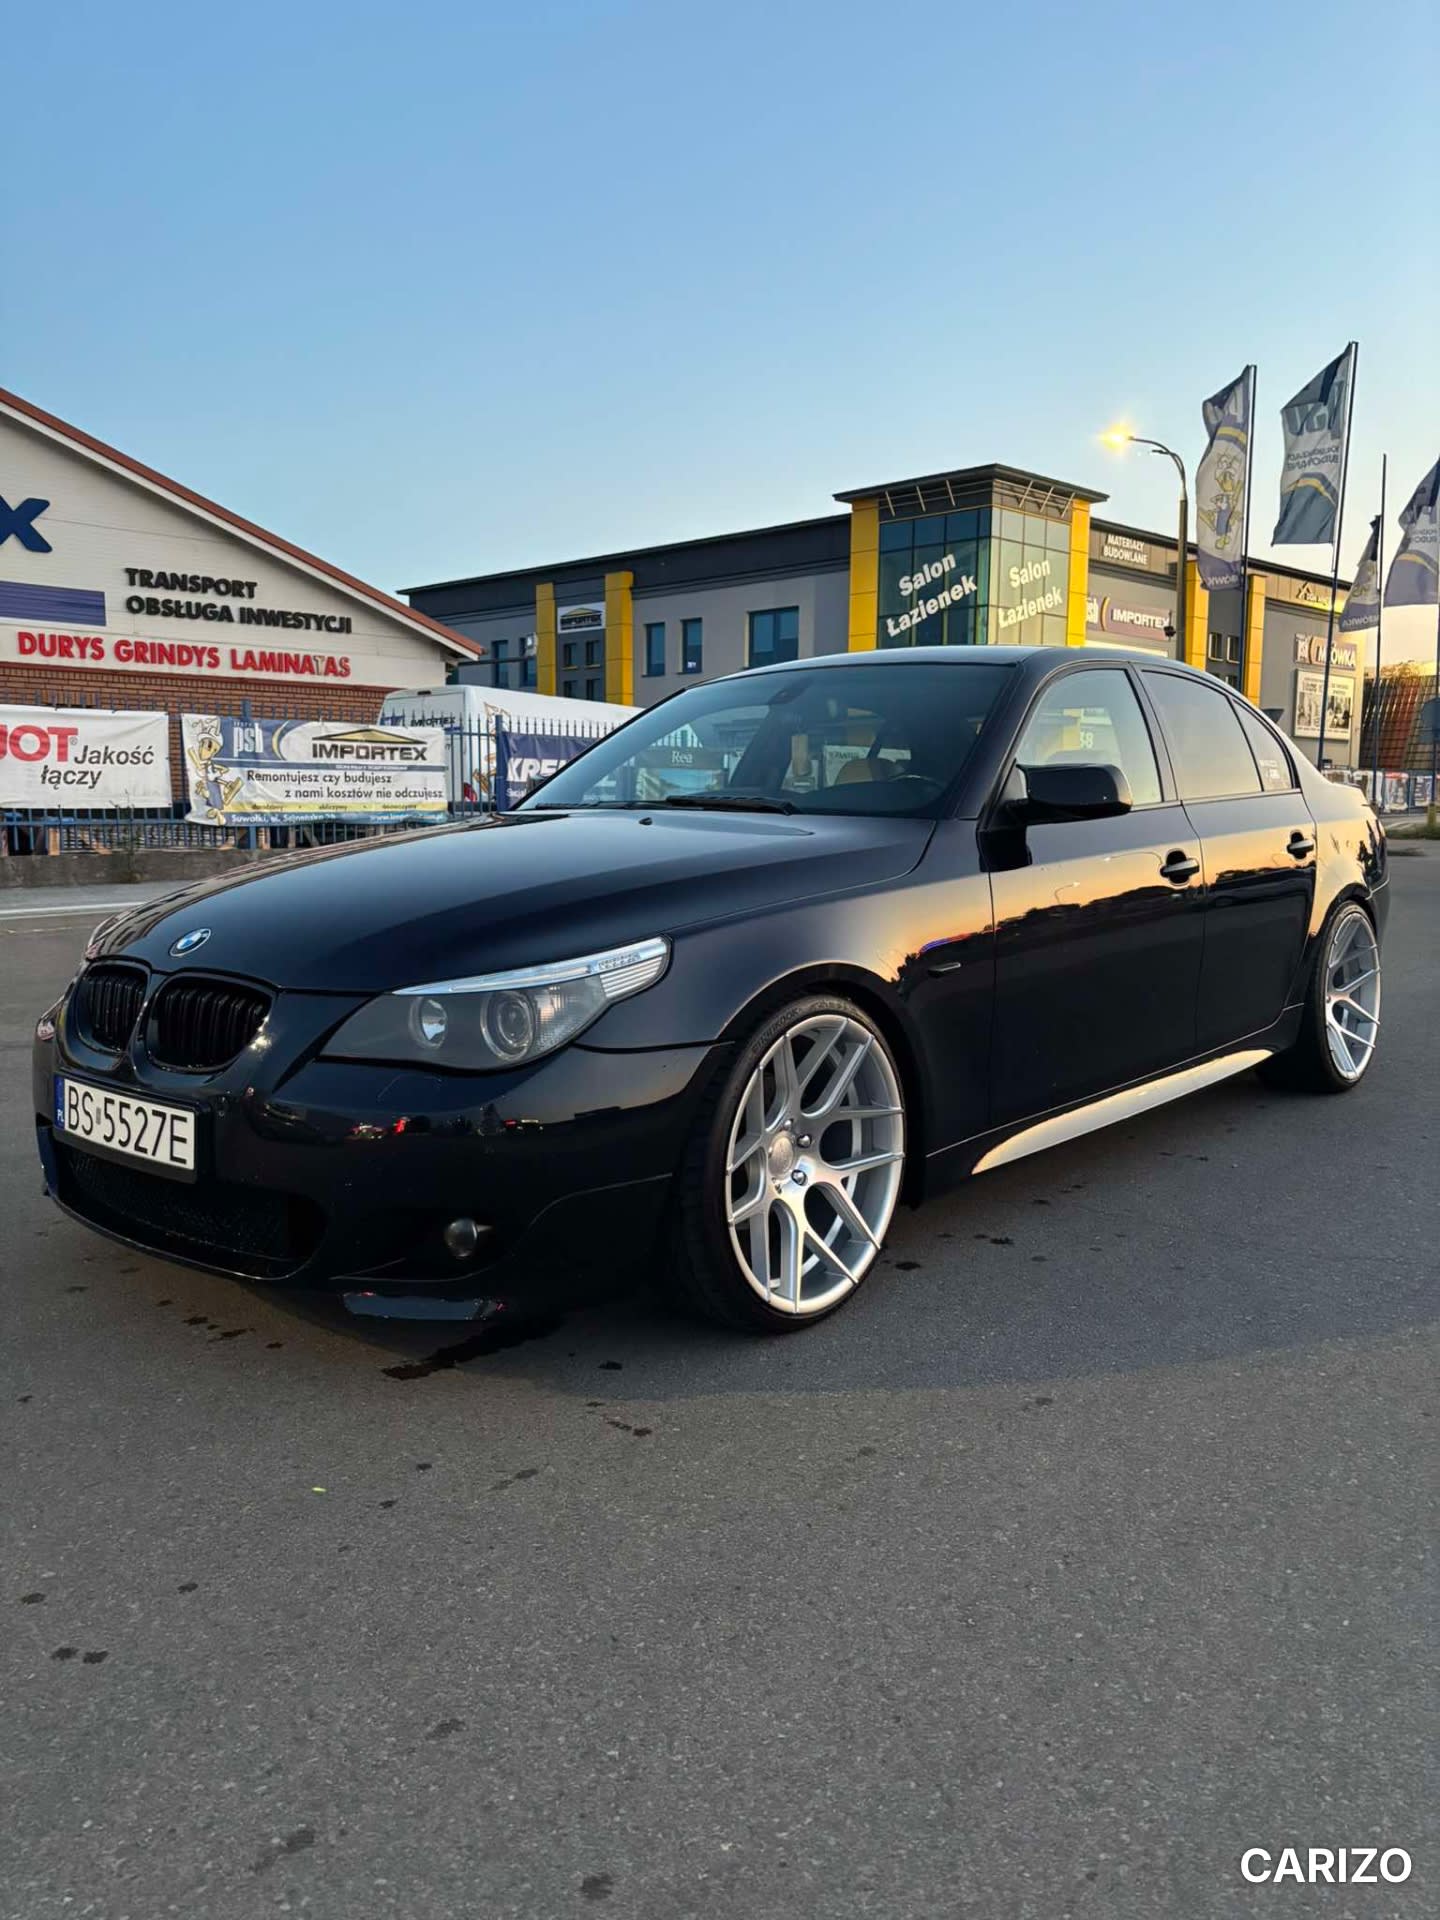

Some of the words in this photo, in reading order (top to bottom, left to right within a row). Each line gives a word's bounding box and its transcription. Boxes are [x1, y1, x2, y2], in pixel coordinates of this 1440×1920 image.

[1103, 546, 1148, 565] BUDOWLANE
[125, 567, 257, 599] TRANSPORT
[899, 553, 957, 597] Salon
[1009, 559, 1051, 588] Salon
[126, 595, 234, 623] OBSŁUGA
[239, 607, 352, 634] INWESTYCJI
[886, 575, 978, 637] Łazienek
[1112, 608, 1170, 628] IMPORTEX
[18, 632, 105, 661] DURYS
[114, 640, 220, 669] GRINDYS
[230, 649, 351, 678] LAMINATAS
[74, 745, 155, 765] Jakość
[312, 743, 428, 761] IMPORTEX
[40, 765, 102, 790] łączy
[247, 770, 319, 785] Remontujesz
[323, 773, 340, 785] czy
[344, 772, 392, 785] budujesz
[285, 789, 291, 798] z
[295, 786, 323, 798] nami
[327, 787, 373, 798] kosztów
[376, 787, 392, 798] nie
[395, 787, 444, 800] odczujesz
[68, 1085, 94, 1136] BS
[103, 1096, 188, 1165] 5527E
